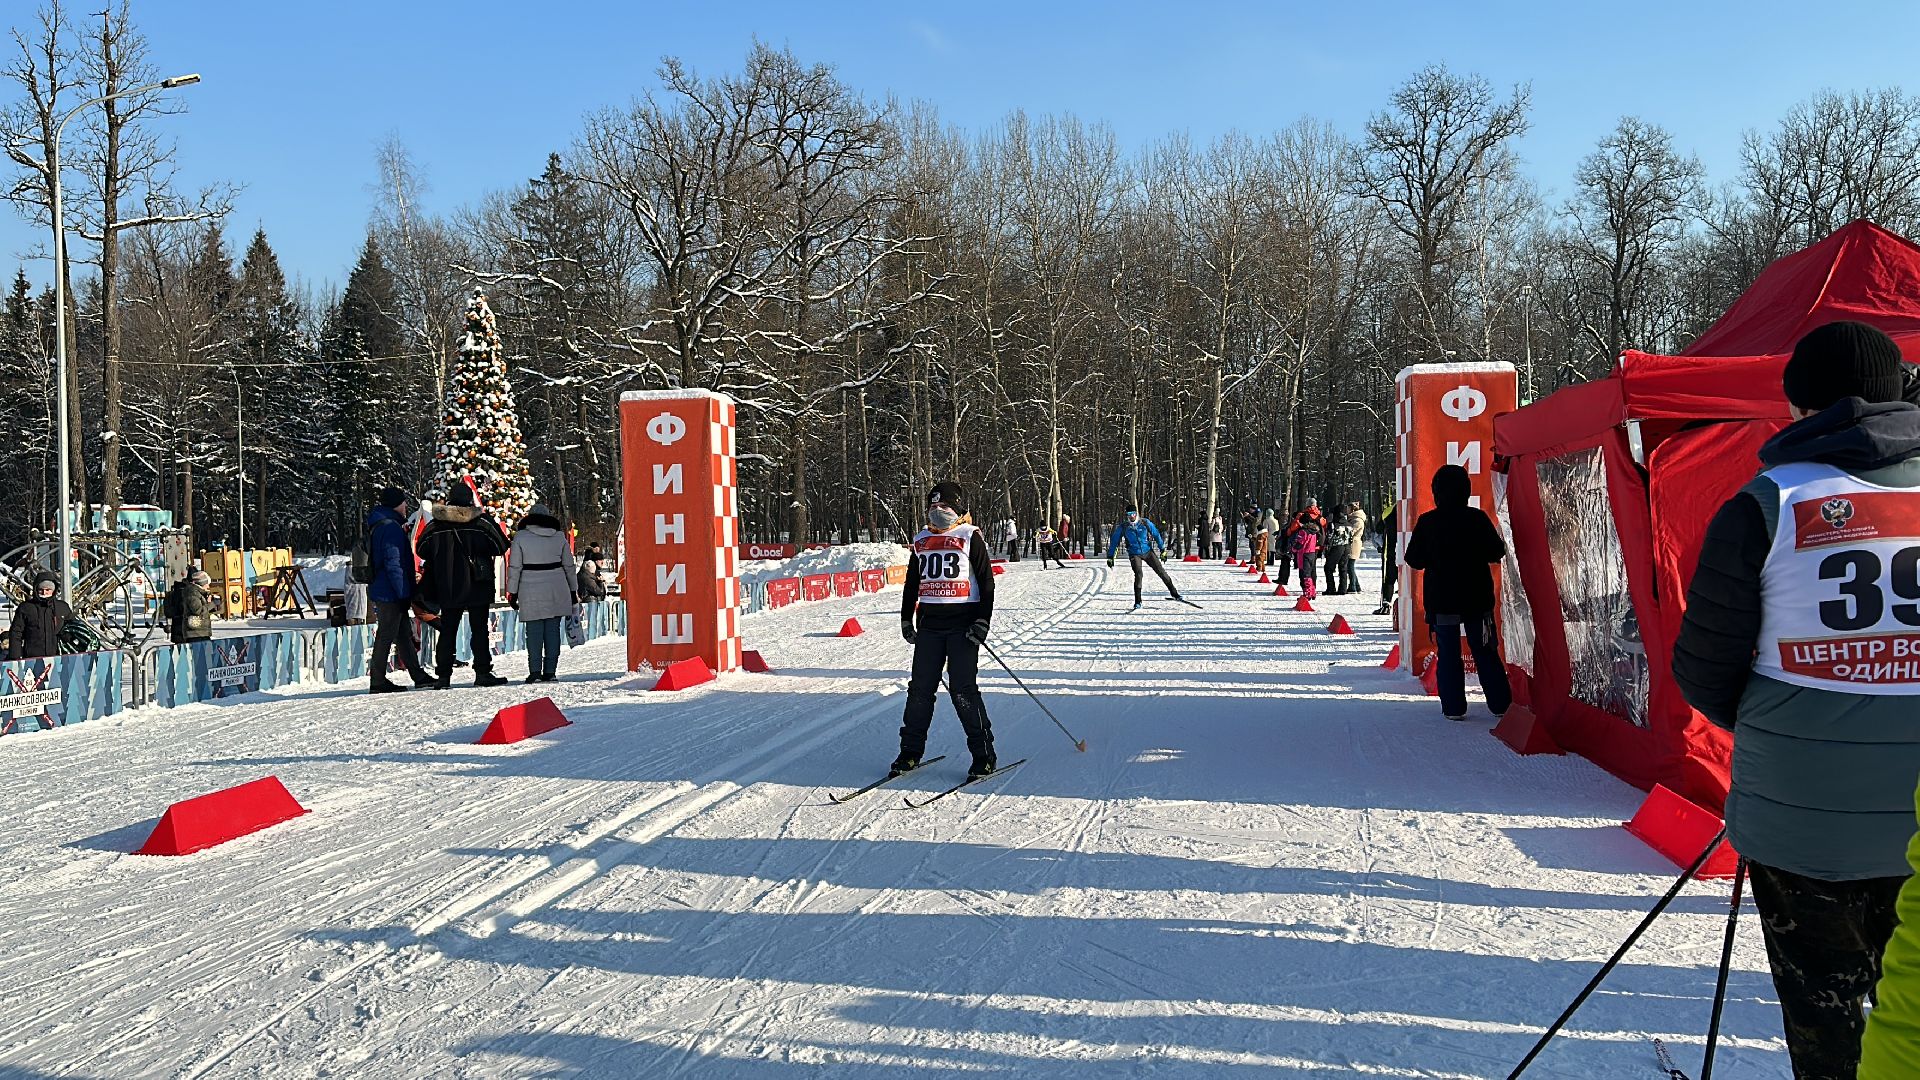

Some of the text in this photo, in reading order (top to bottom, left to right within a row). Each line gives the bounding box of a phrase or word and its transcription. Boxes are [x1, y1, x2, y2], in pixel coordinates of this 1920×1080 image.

[646, 412, 694, 645] ФИНИШ
[919, 553, 960, 579] 203
[1793, 641, 1885, 665] ЦЕНТР
